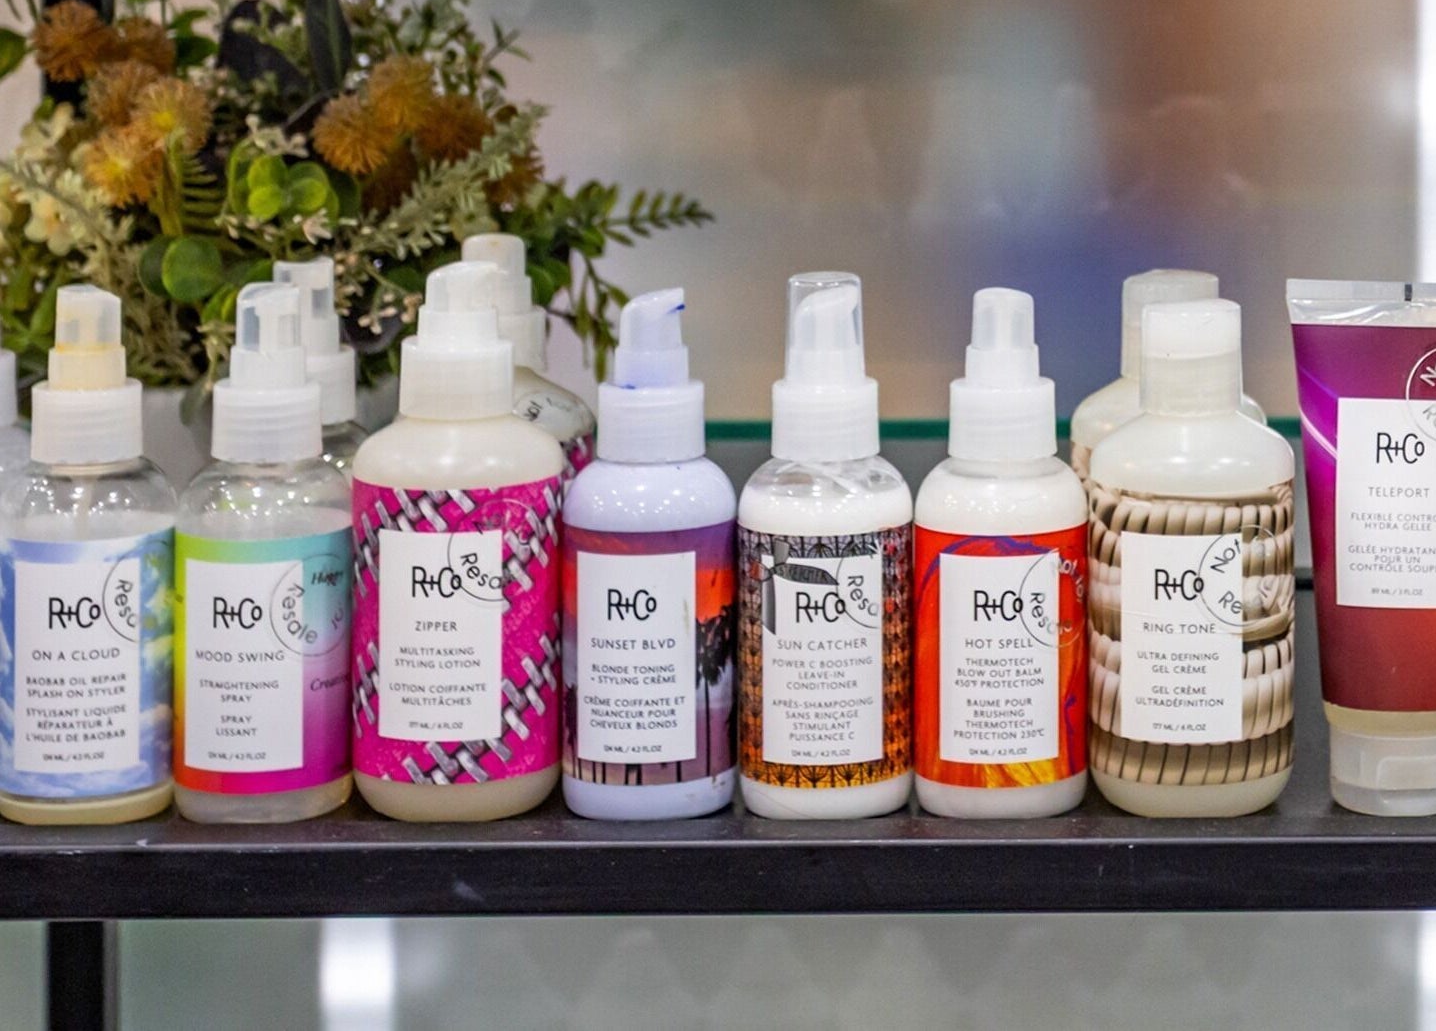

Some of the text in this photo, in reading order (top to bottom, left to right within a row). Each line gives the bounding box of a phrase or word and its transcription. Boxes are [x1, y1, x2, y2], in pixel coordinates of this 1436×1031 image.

[1376, 432, 1425, 464] R+Co
[1368, 487, 1430, 498] TELEPORT
[412, 566, 462, 598] R+Co
[1155, 569, 1204, 600] R+Co
[608, 589, 657, 621] R+Co
[796, 591, 845, 623] R+Co
[974, 590, 1023, 621] R+Co
[49, 597, 100, 629] R+Co
[213, 597, 262, 629] R+Co
[415, 621, 458, 632] ZIPPER
[1143, 623, 1215, 634] RING TONE
[591, 638, 676, 650] SUNSET BLVD
[777, 638, 868, 651] SUN CATCHER
[965, 639, 1033, 649] HOT SPELL
[33, 648, 120, 661] ON A CLOUD
[195, 650, 285, 662] MOOD SWING
[966, 658, 1033, 667] THERMOTECH
